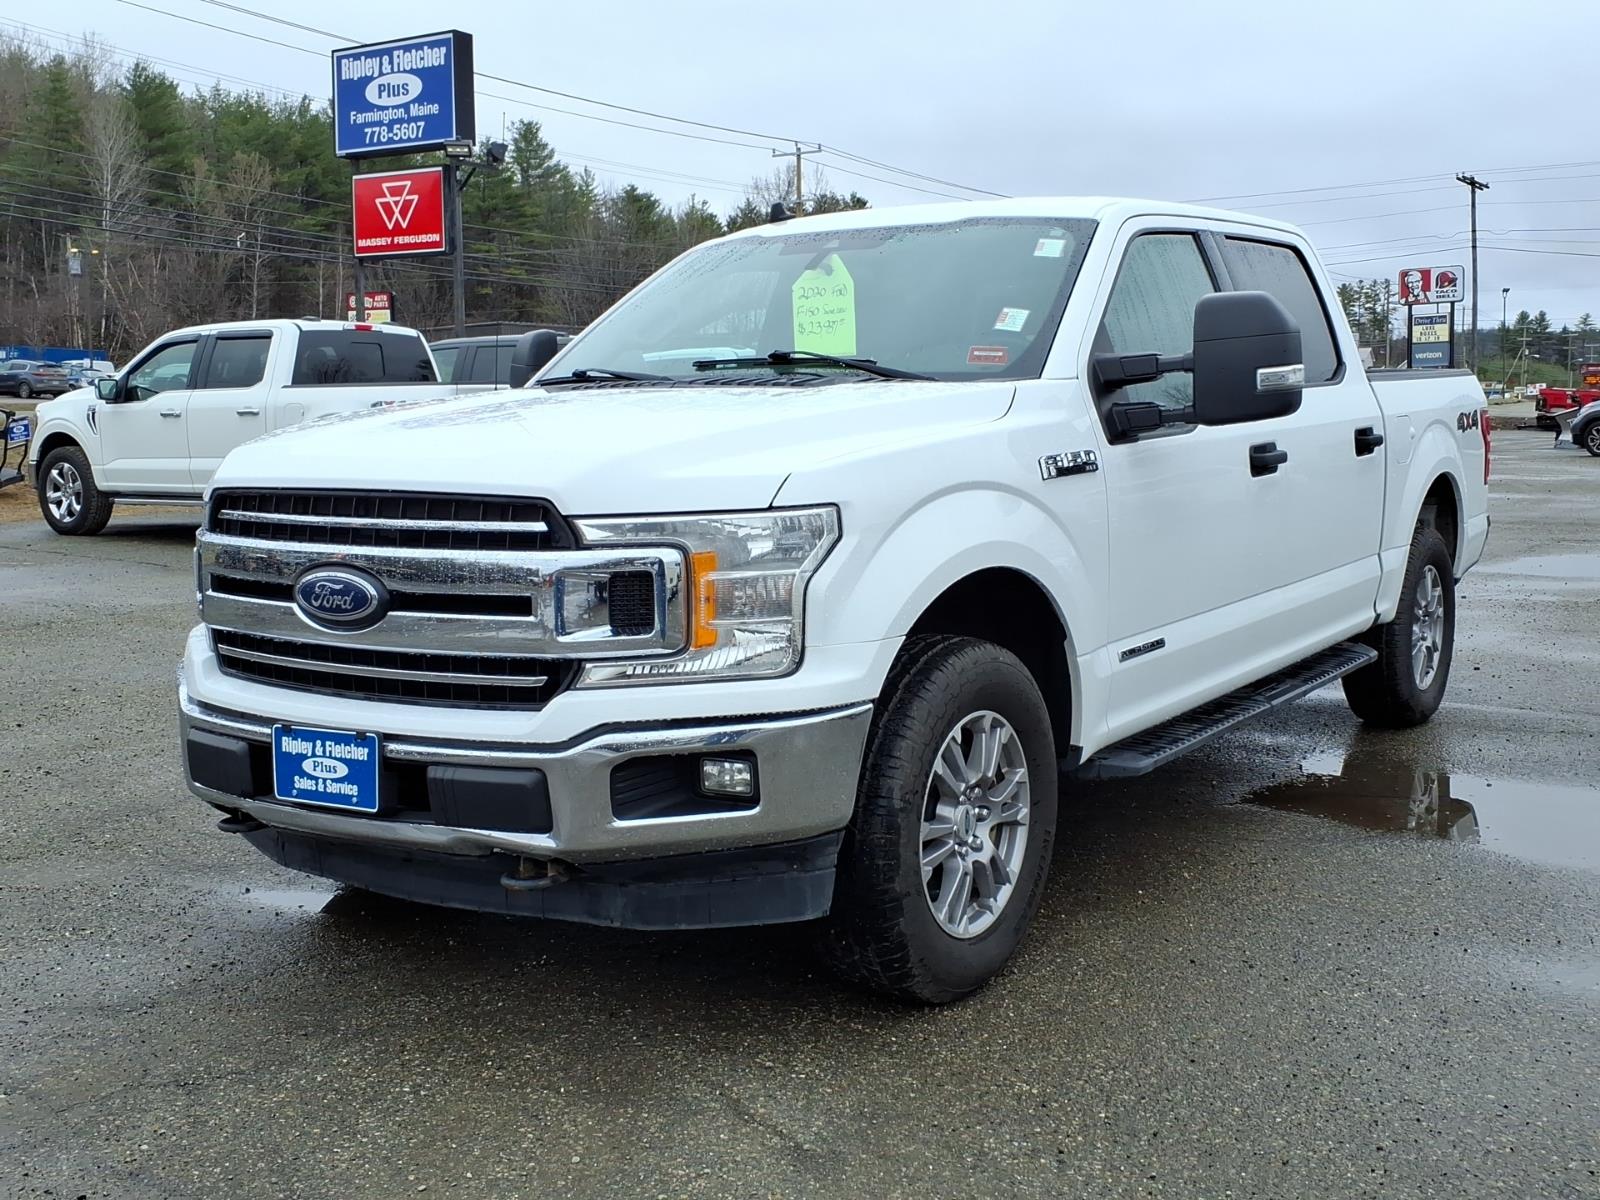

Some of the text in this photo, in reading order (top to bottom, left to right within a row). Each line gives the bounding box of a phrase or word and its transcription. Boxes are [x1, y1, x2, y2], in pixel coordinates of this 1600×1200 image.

[341, 46, 447, 80] Ripley & Fletcher
[378, 82, 410, 99] Plus
[350, 102, 439, 125] Farmington, Maine
[364, 121, 425, 144] 778-5607
[358, 234, 440, 247] MASSEY FERGUSON
[311, 581, 354, 609] Ford
[281, 736, 369, 761] Ripley & Fletcher
[312, 760, 338, 774] Plus
[294, 775, 358, 796] Sales & Service
